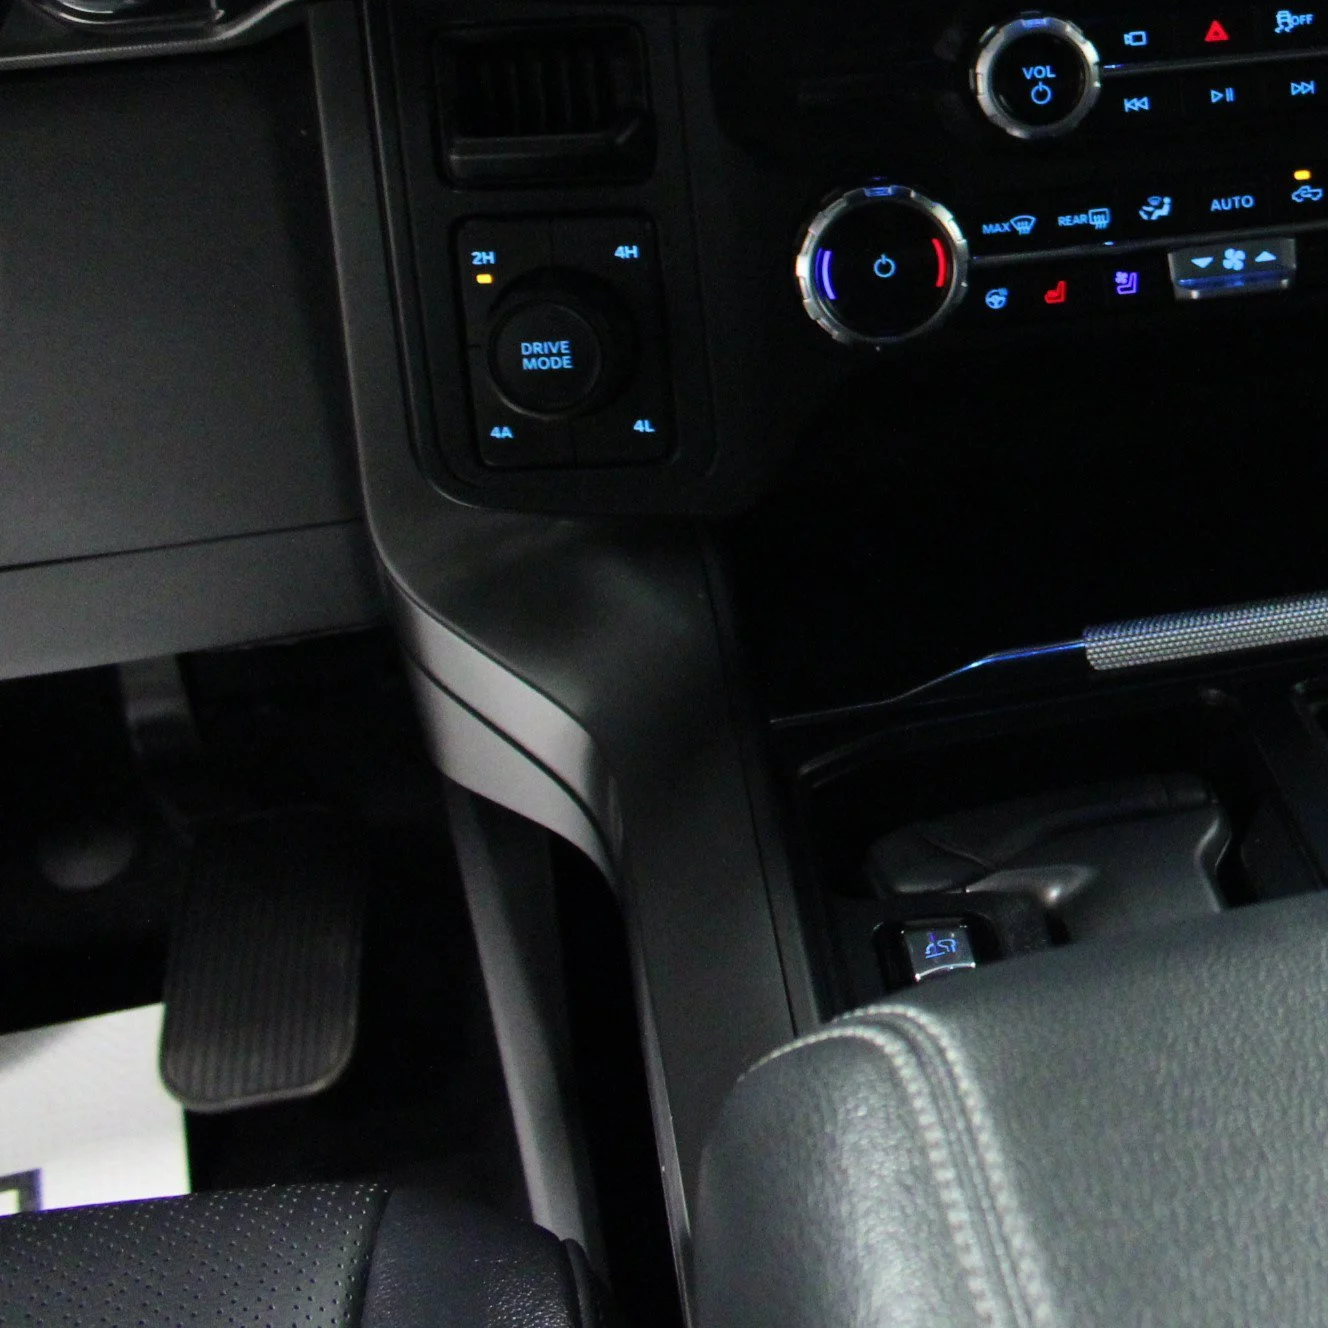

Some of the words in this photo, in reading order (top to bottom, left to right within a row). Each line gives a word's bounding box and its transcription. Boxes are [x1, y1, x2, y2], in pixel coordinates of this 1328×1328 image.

[1290, 12, 1315, 27] OFF
[1021, 64, 1057, 80] VOL
[1210, 194, 1255, 212] AUTO
[1057, 213, 1088, 227] REAR
[981, 222, 1011, 235] MAX
[471, 251, 496, 265] 2H
[614, 244, 640, 260] 4H
[520, 340, 571, 356] DRIVE
[522, 356, 574, 371] MODE
[490, 426, 515, 439] 4A
[633, 420, 656, 434] 4L
